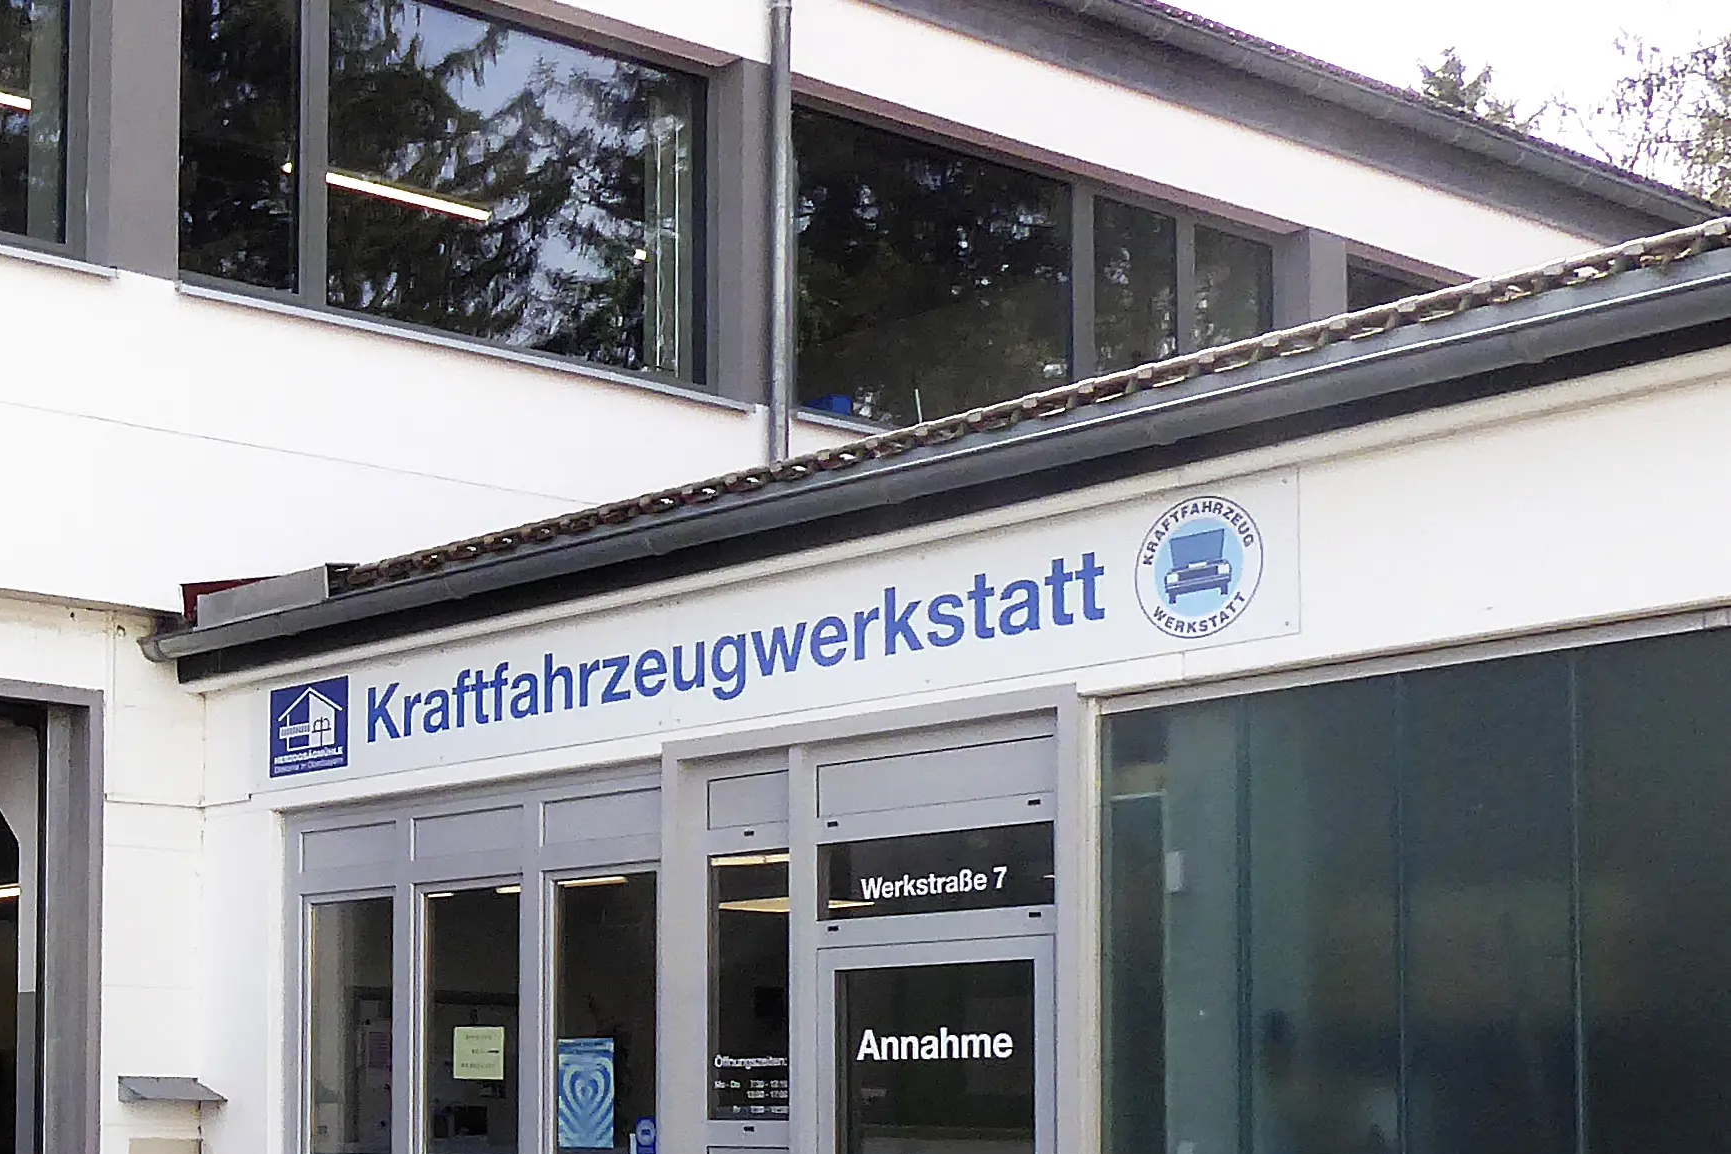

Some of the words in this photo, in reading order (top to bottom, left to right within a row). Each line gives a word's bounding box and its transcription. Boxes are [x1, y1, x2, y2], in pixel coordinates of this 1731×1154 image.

[1143, 501, 1255, 566] KRAFTFAHRZEUG
[1153, 591, 1246, 633] WERKSTATT
[366, 552, 1106, 743] Kraftfahrzeugwerkstatt
[860, 868, 988, 900] Werkstraße
[992, 866, 1008, 889] 7
[856, 1026, 1014, 1061] Annahme
